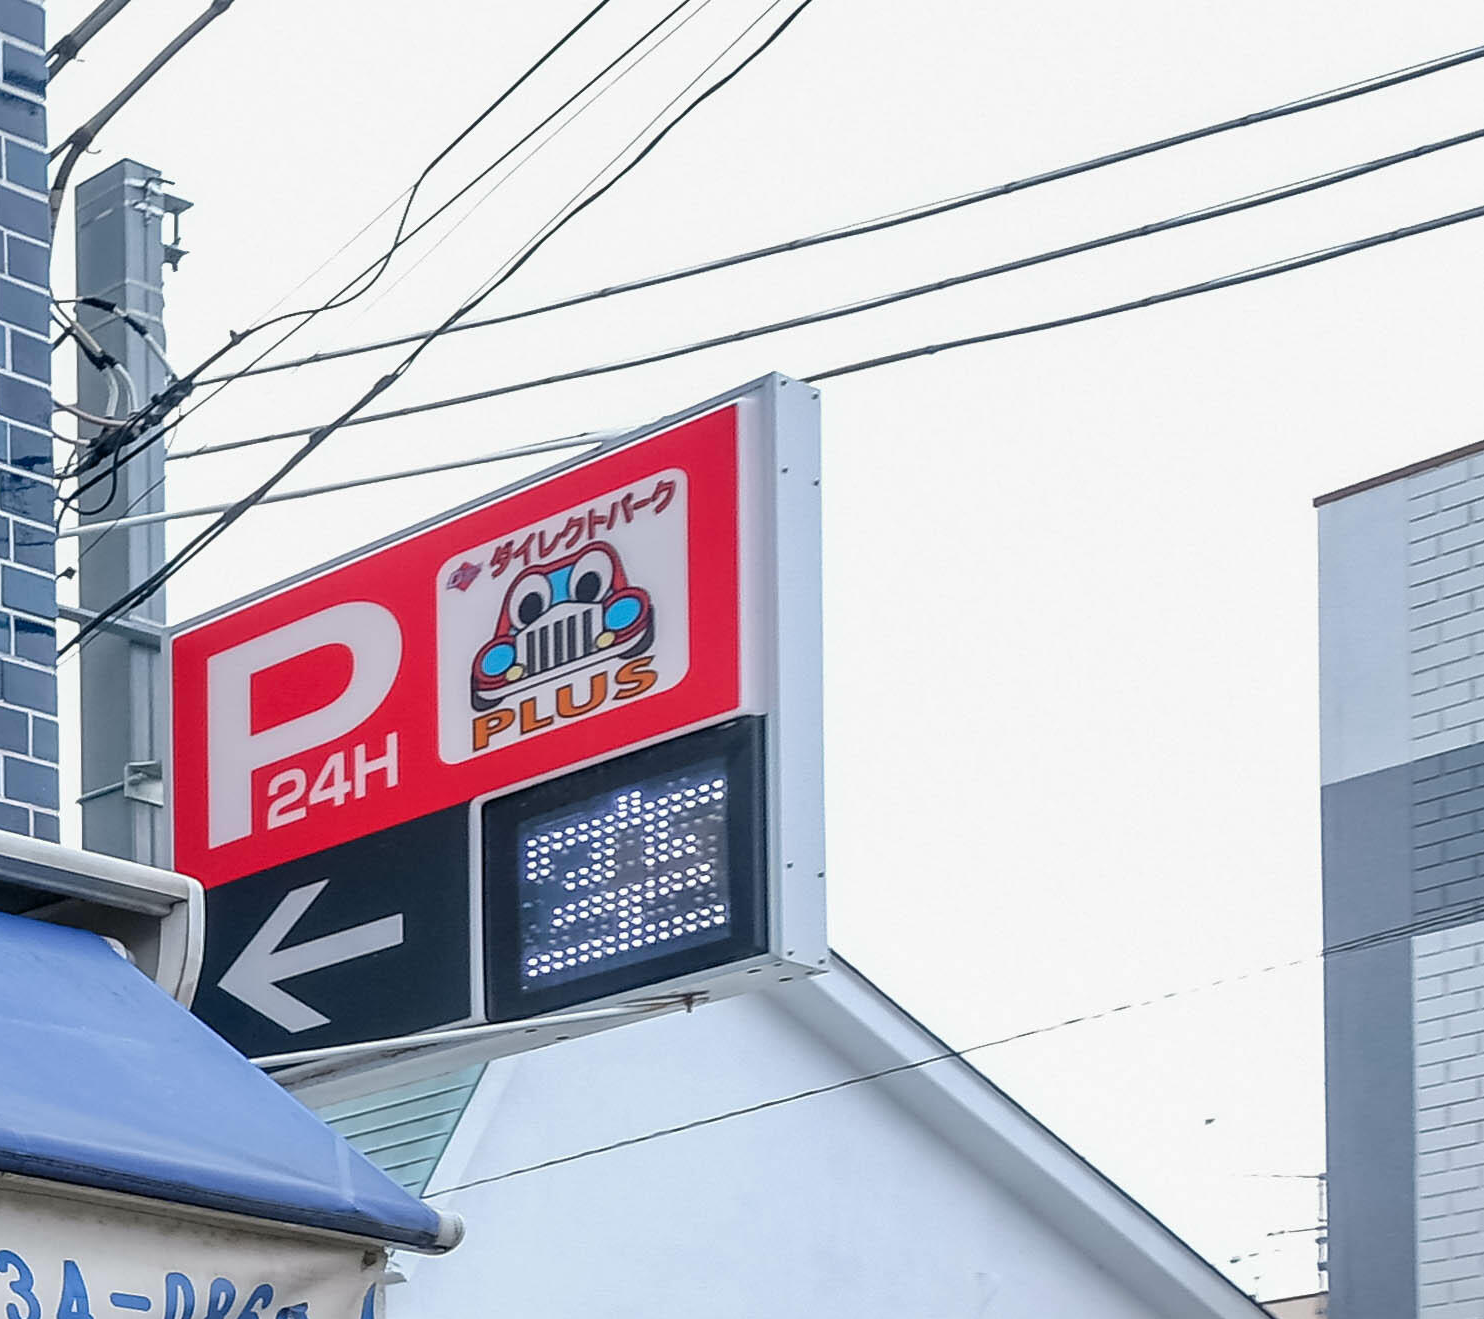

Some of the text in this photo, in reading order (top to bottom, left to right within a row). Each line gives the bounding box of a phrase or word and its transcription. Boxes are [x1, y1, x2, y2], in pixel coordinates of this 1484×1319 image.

[489, 479, 677, 580] ダイレクトパーク
[206, 600, 403, 850] P
[471, 655, 659, 753] PLUS
[266, 730, 400, 833] 24H
